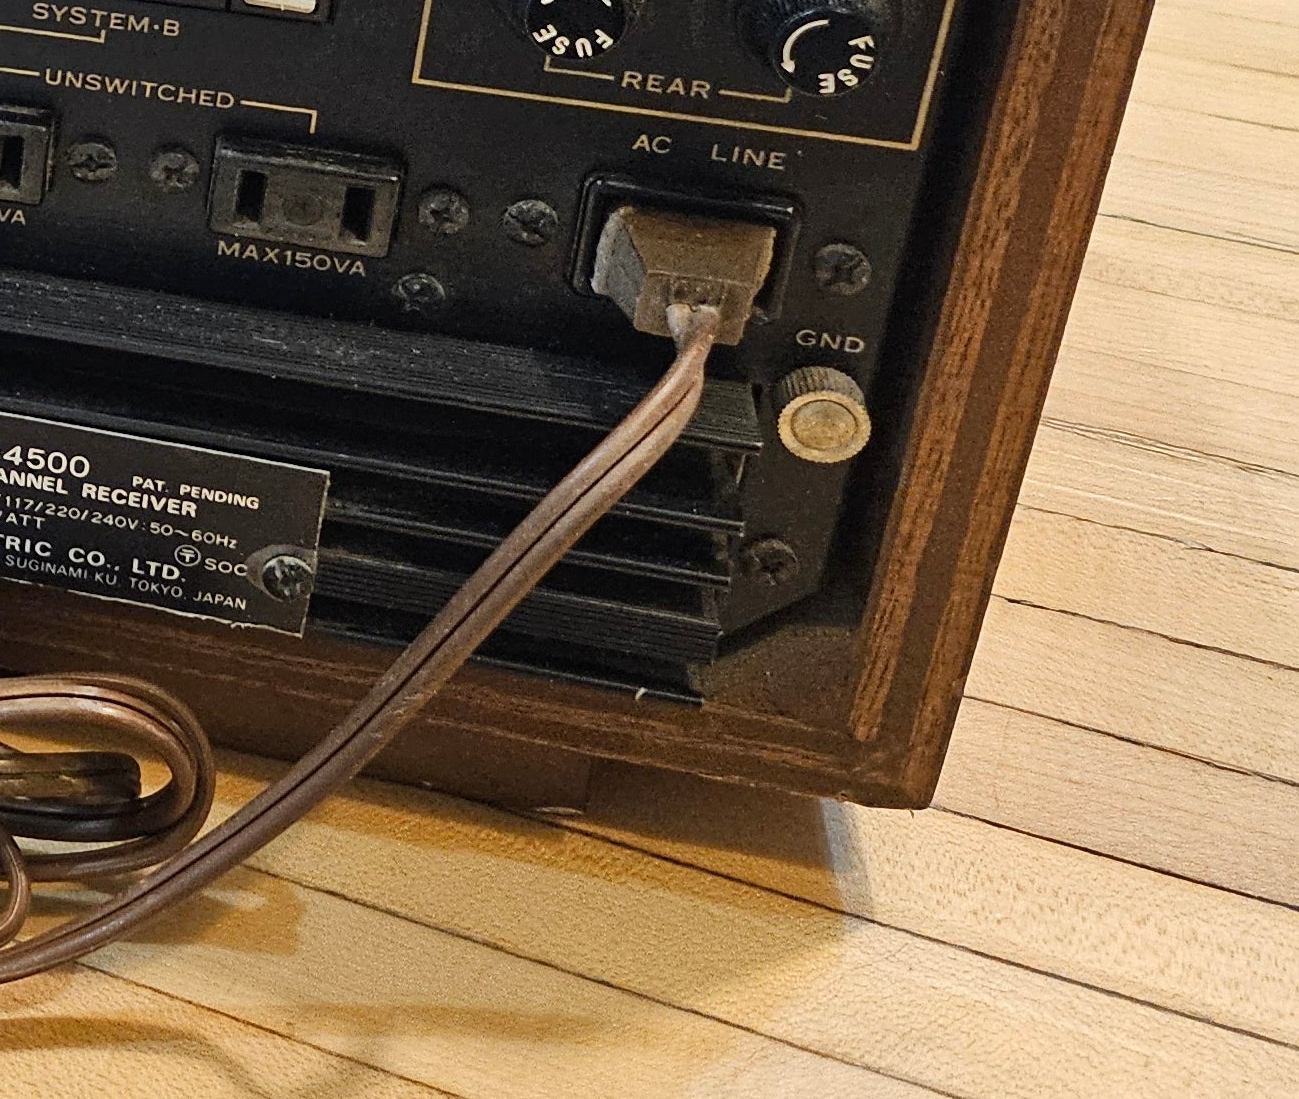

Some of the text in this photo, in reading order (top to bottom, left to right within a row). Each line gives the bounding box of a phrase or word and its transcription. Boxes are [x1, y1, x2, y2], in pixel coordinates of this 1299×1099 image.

[533, 23, 614, 59] FUSE
[818, 34, 874, 95] FUSE
[44, 68, 235, 108] UNSWITCHED
[621, 69, 711, 99] REAR
[632, 134, 787, 172] AC LINE
[795, 329, 866, 353] GND
[81, 482, 198, 518] RECEIVER
[132, 475, 260, 510] PAT. PENDING
[131, 558, 186, 583] LTD.
[203, 557, 248, 577] SOC
[192, 591, 247, 611] JAPAN
